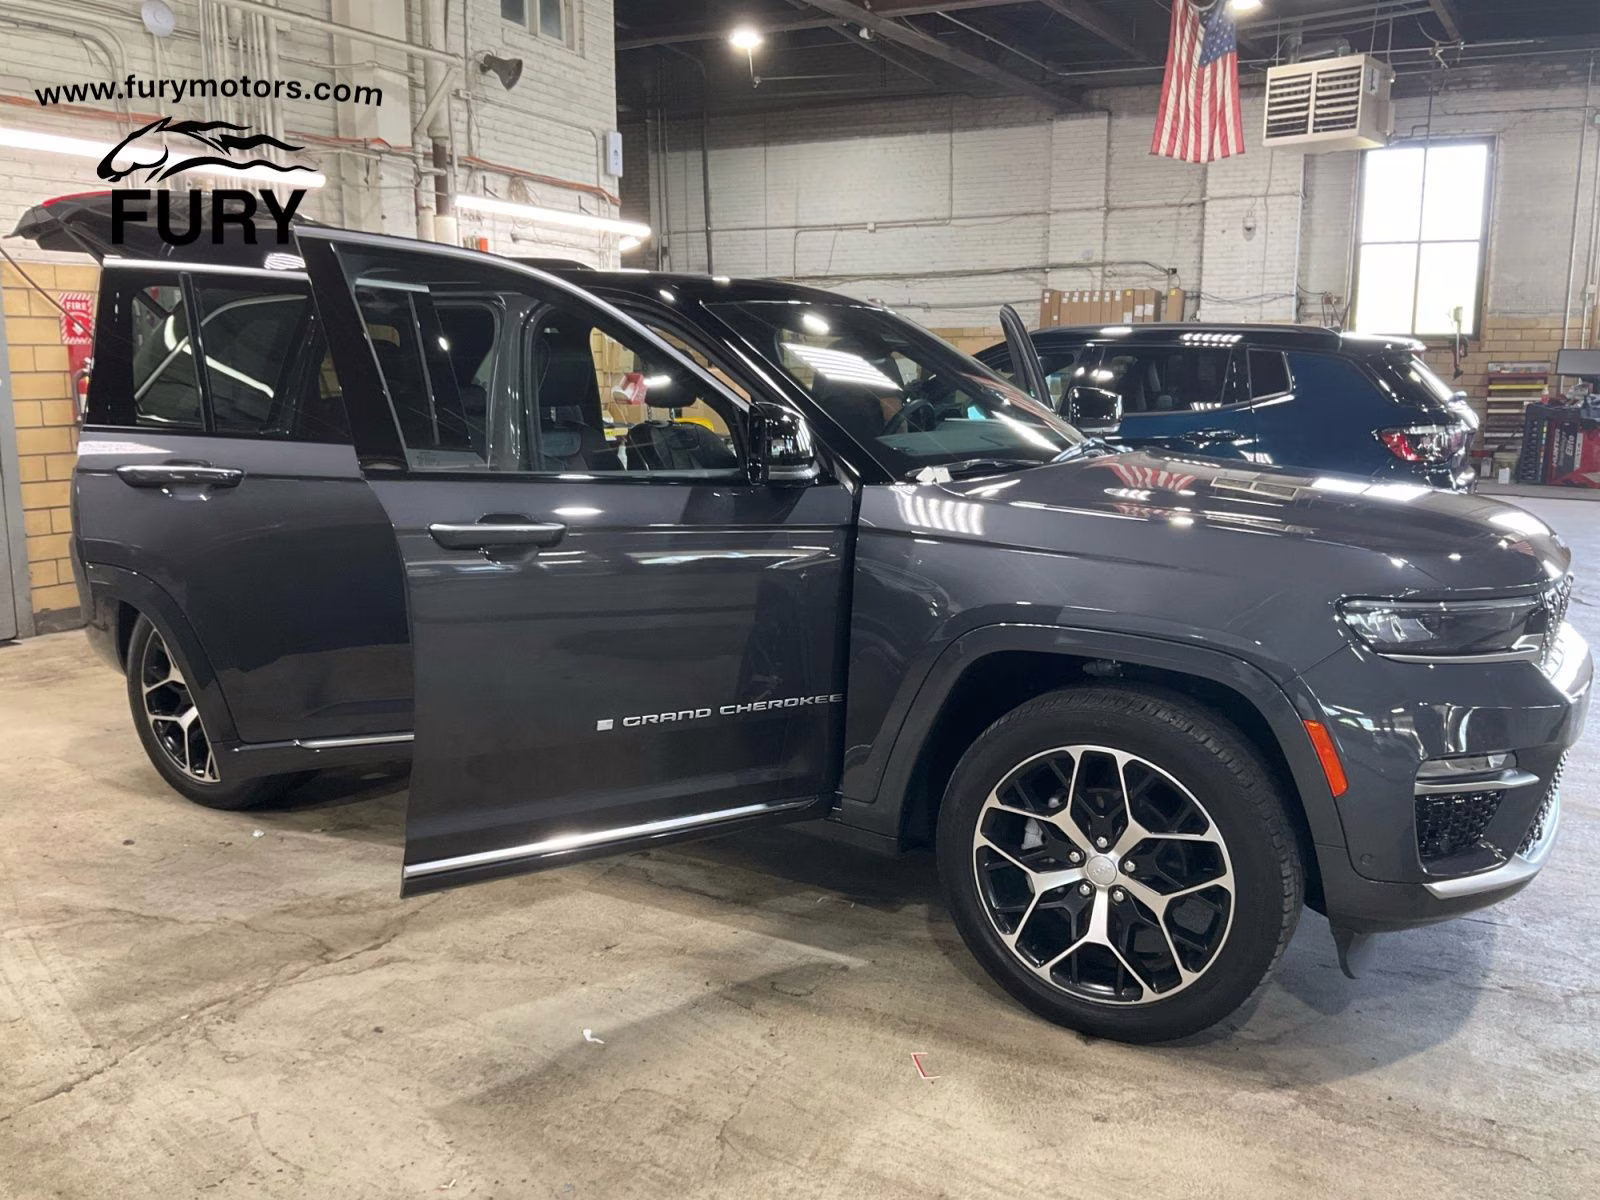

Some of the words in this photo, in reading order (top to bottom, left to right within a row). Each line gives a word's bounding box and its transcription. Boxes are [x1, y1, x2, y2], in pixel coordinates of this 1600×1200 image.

[65, 301, 87, 310] FIRE
[1552, 428, 1560, 467] HUNTER
[1566, 435, 1575, 456] Elite
[622, 708, 712, 727] GRAND
[719, 693, 843, 715] CHEROKEE
